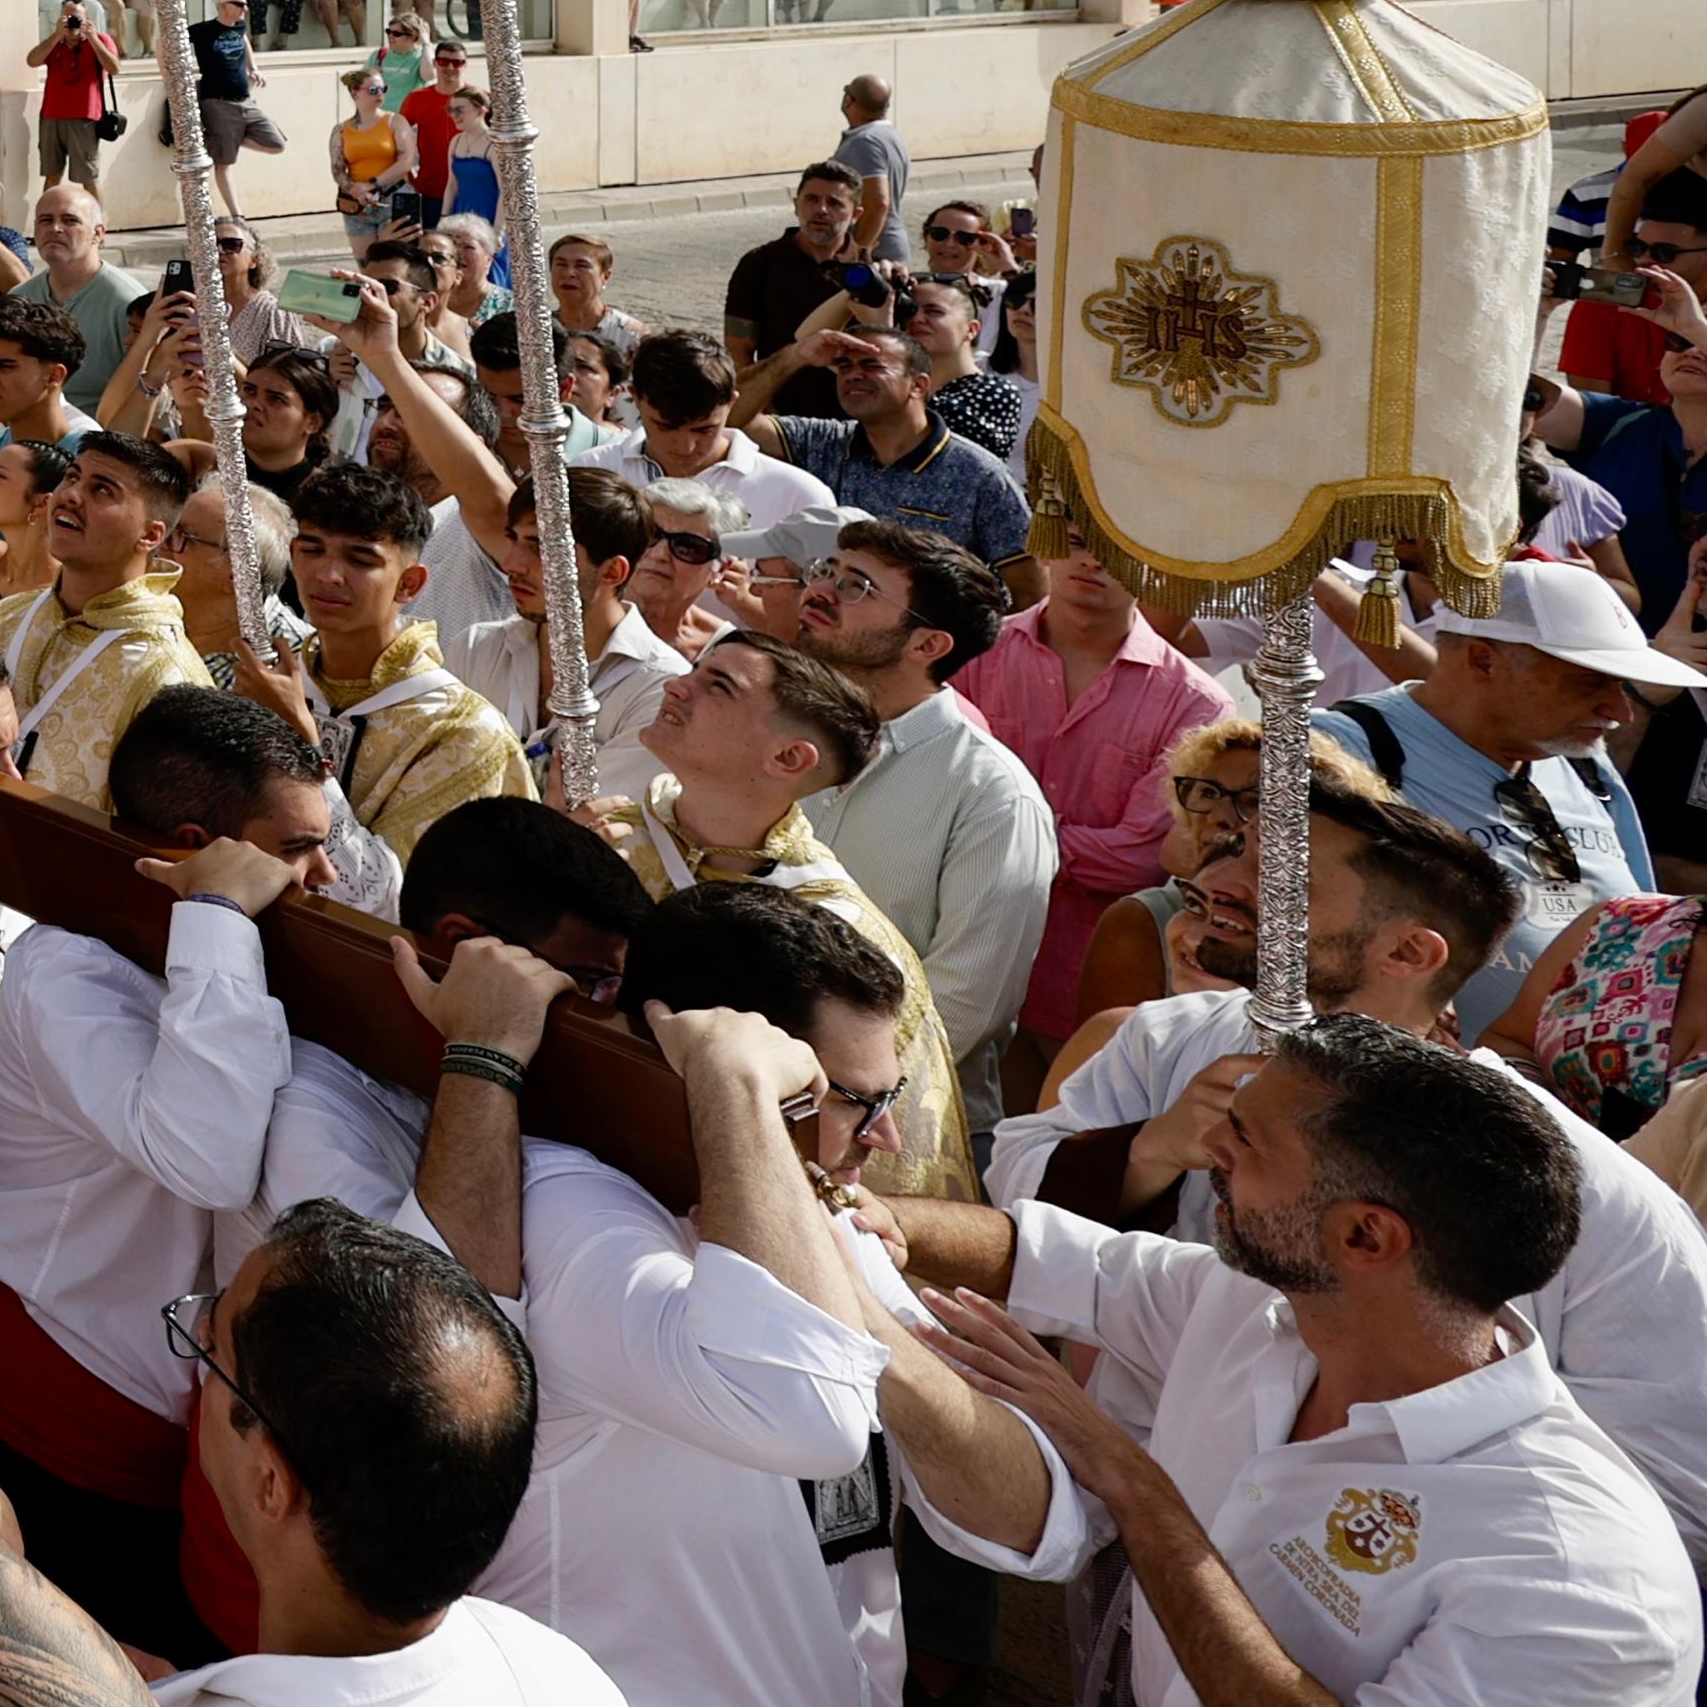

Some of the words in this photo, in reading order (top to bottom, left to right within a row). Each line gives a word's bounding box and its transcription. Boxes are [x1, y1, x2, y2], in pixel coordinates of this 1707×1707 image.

[1143, 304, 1247, 359] IHS
[1542, 897, 1578, 912] USA
[1268, 1542, 1305, 1582] CARMEN
[1304, 1579, 1362, 1637] CORONADA
